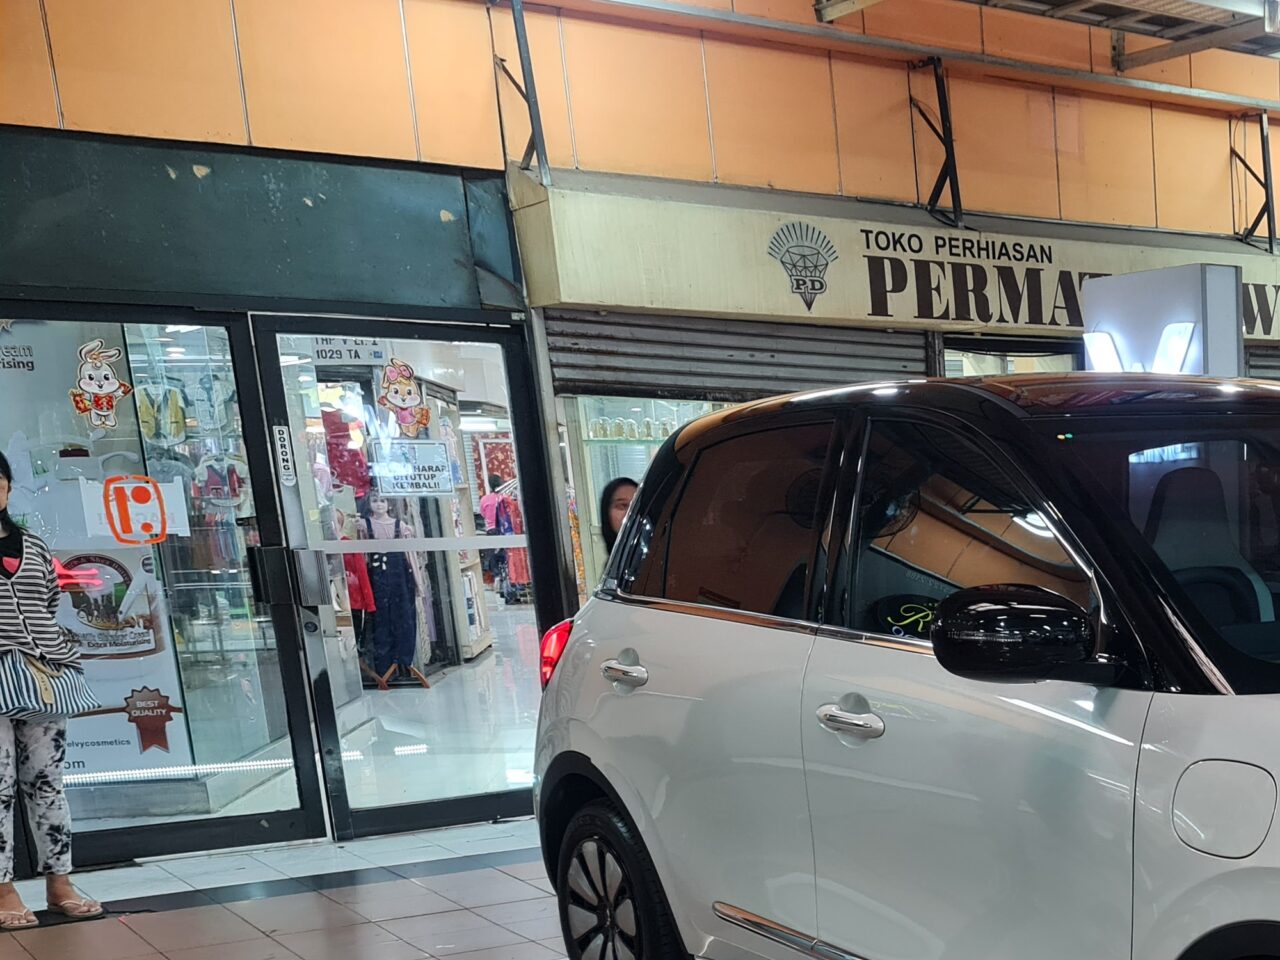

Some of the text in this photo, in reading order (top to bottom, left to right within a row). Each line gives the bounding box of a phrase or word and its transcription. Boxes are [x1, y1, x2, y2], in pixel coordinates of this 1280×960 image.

[860, 229, 1053, 264] TOKO PERHIASAN
[793, 278, 825, 291] PD
[0, 344, 33, 358] eam
[316, 348, 343, 360] 1029
[346, 349, 361, 360] TA
[277, 429, 291, 471] DORONG
[413, 465, 447, 473] HARAP
[136, 700, 159, 708] BEST
[131, 709, 168, 717] QUALITY
[66, 738, 131, 749] elvycosmetics
[64, 759, 86, 769] om
